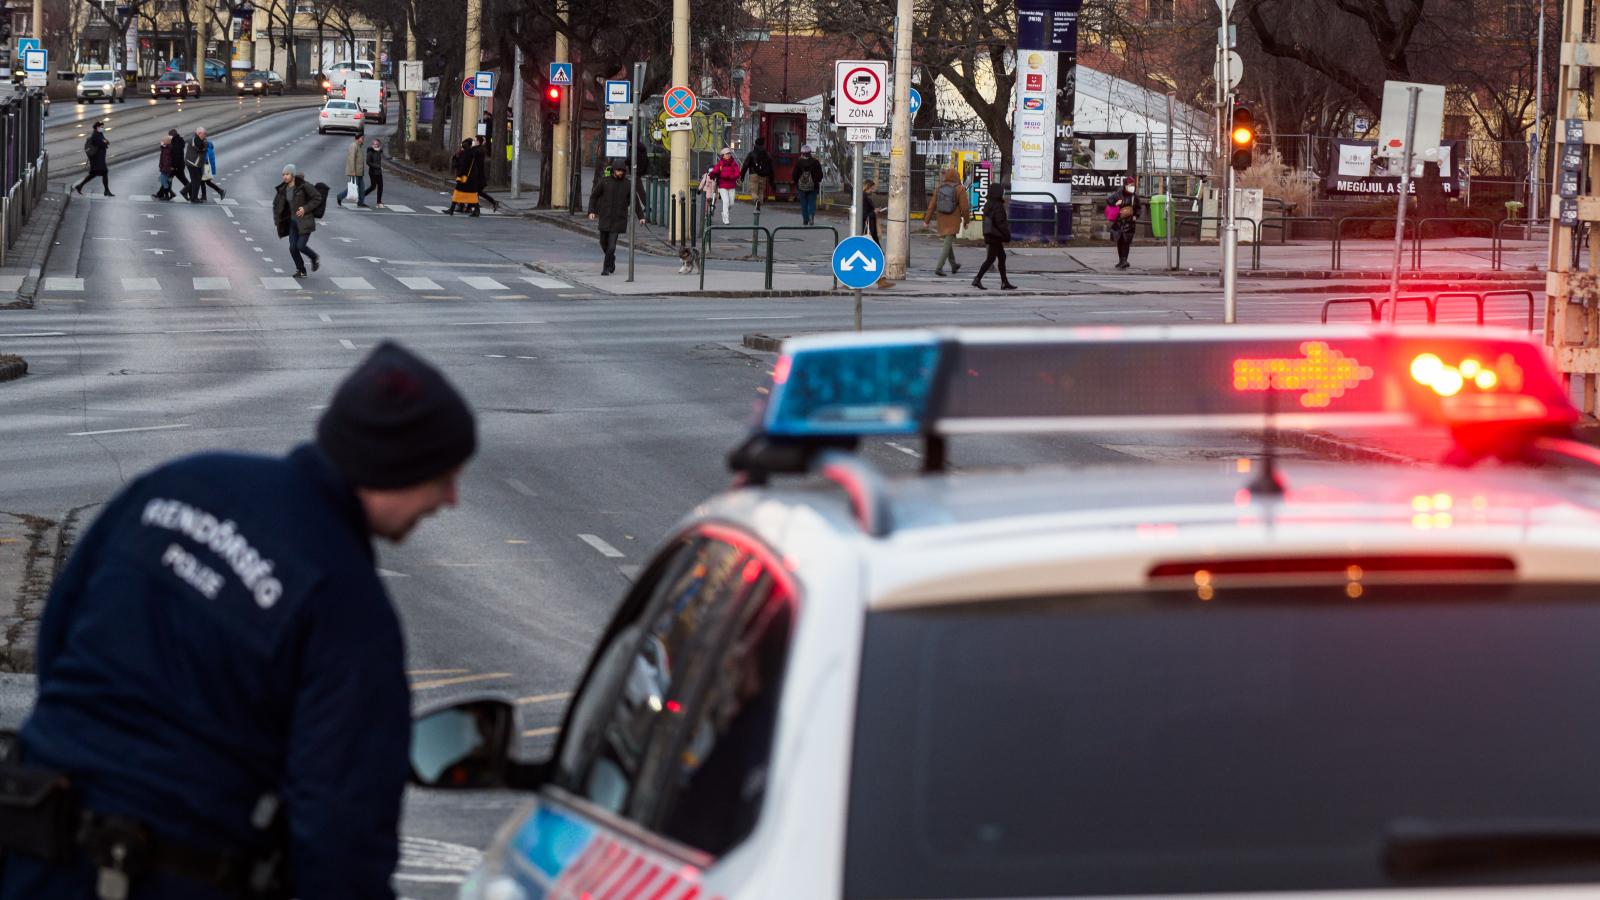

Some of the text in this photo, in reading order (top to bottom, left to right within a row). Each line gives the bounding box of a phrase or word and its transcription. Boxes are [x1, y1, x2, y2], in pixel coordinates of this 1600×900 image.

[848, 108, 874, 118] ZÓNA
[1056, 124, 1074, 138] HO
[1071, 173, 1105, 186] SZÉNA
[974, 167, 989, 216] budmil
[1337, 180, 1384, 192] MEGÚJUL
[1387, 183, 1395, 193] A
[161, 543, 226, 600] POLICE
